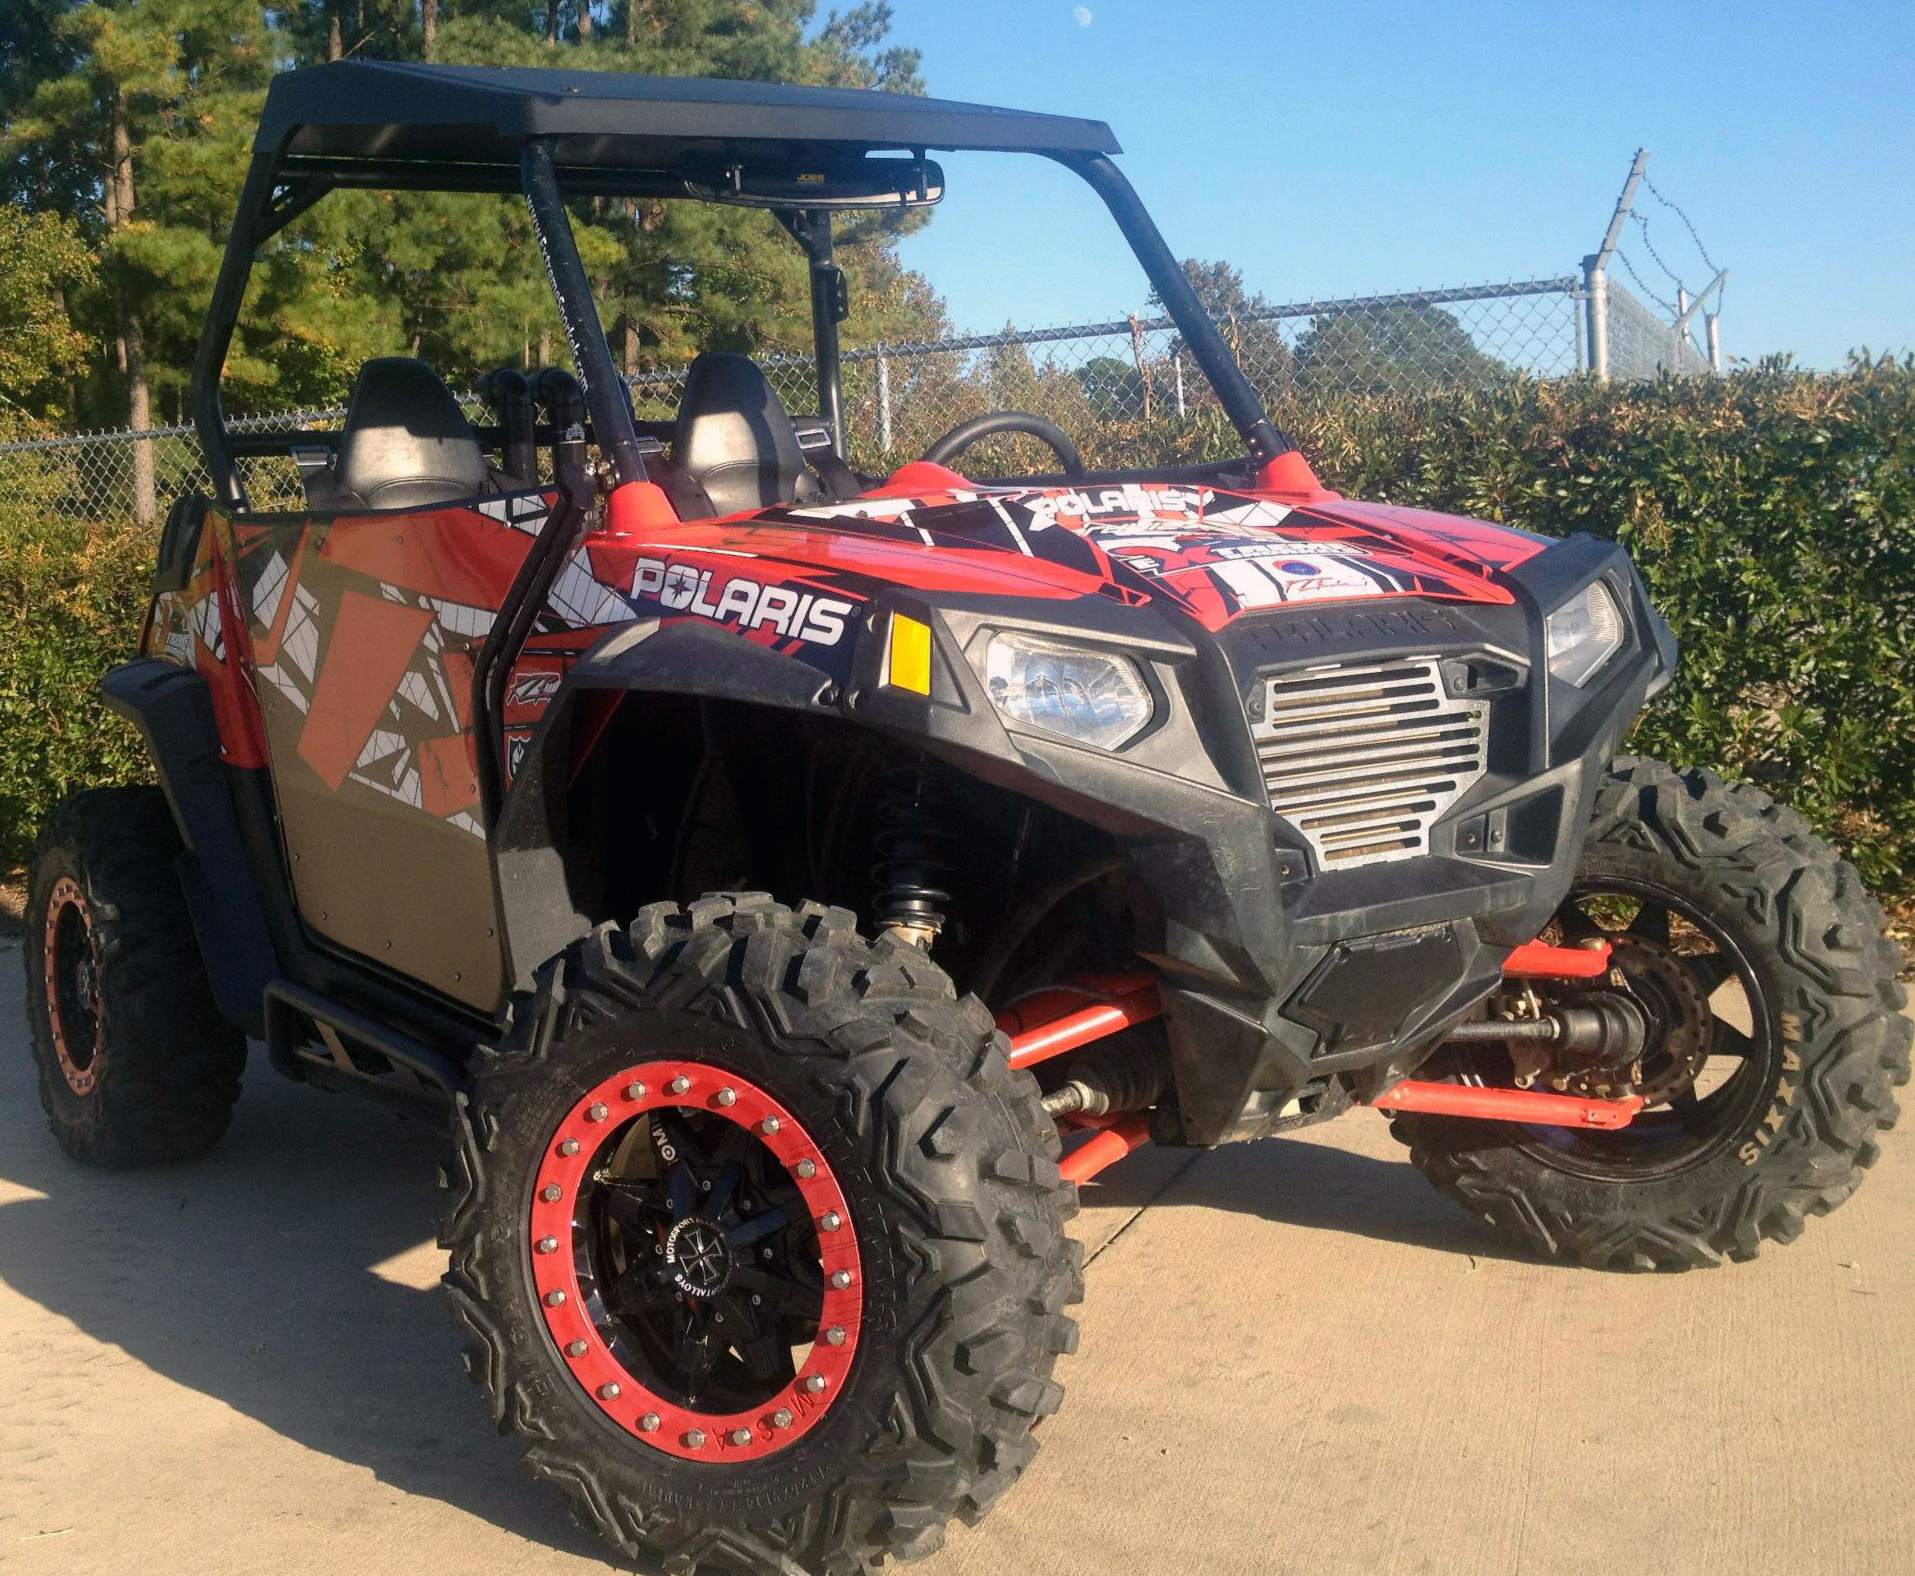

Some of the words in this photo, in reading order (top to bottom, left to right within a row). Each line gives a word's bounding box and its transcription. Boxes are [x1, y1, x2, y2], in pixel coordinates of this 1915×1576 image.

[1038, 489, 1188, 522] POLARIS
[630, 557, 854, 647] POLARIS
[1240, 607, 1458, 650] POLARIS
